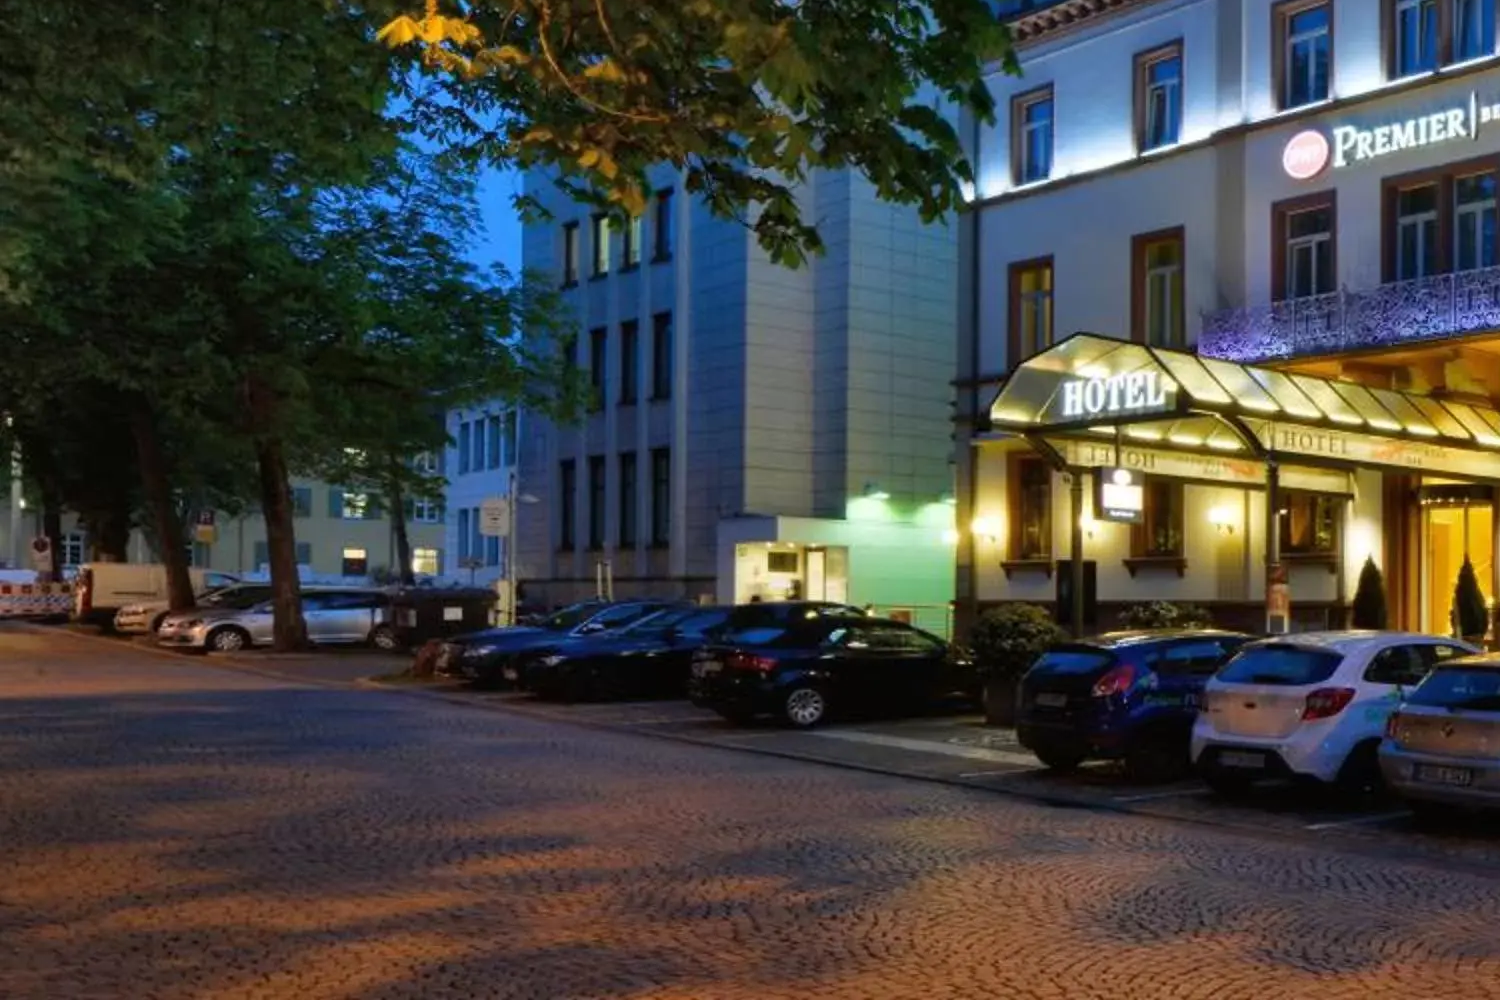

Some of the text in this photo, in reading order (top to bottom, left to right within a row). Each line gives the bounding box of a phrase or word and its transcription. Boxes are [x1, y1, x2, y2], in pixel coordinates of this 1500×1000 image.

[1333, 108, 1467, 167] PREMIER
[1063, 370, 1166, 416] HOTEL
[1284, 430, 1350, 455] HOTEL
